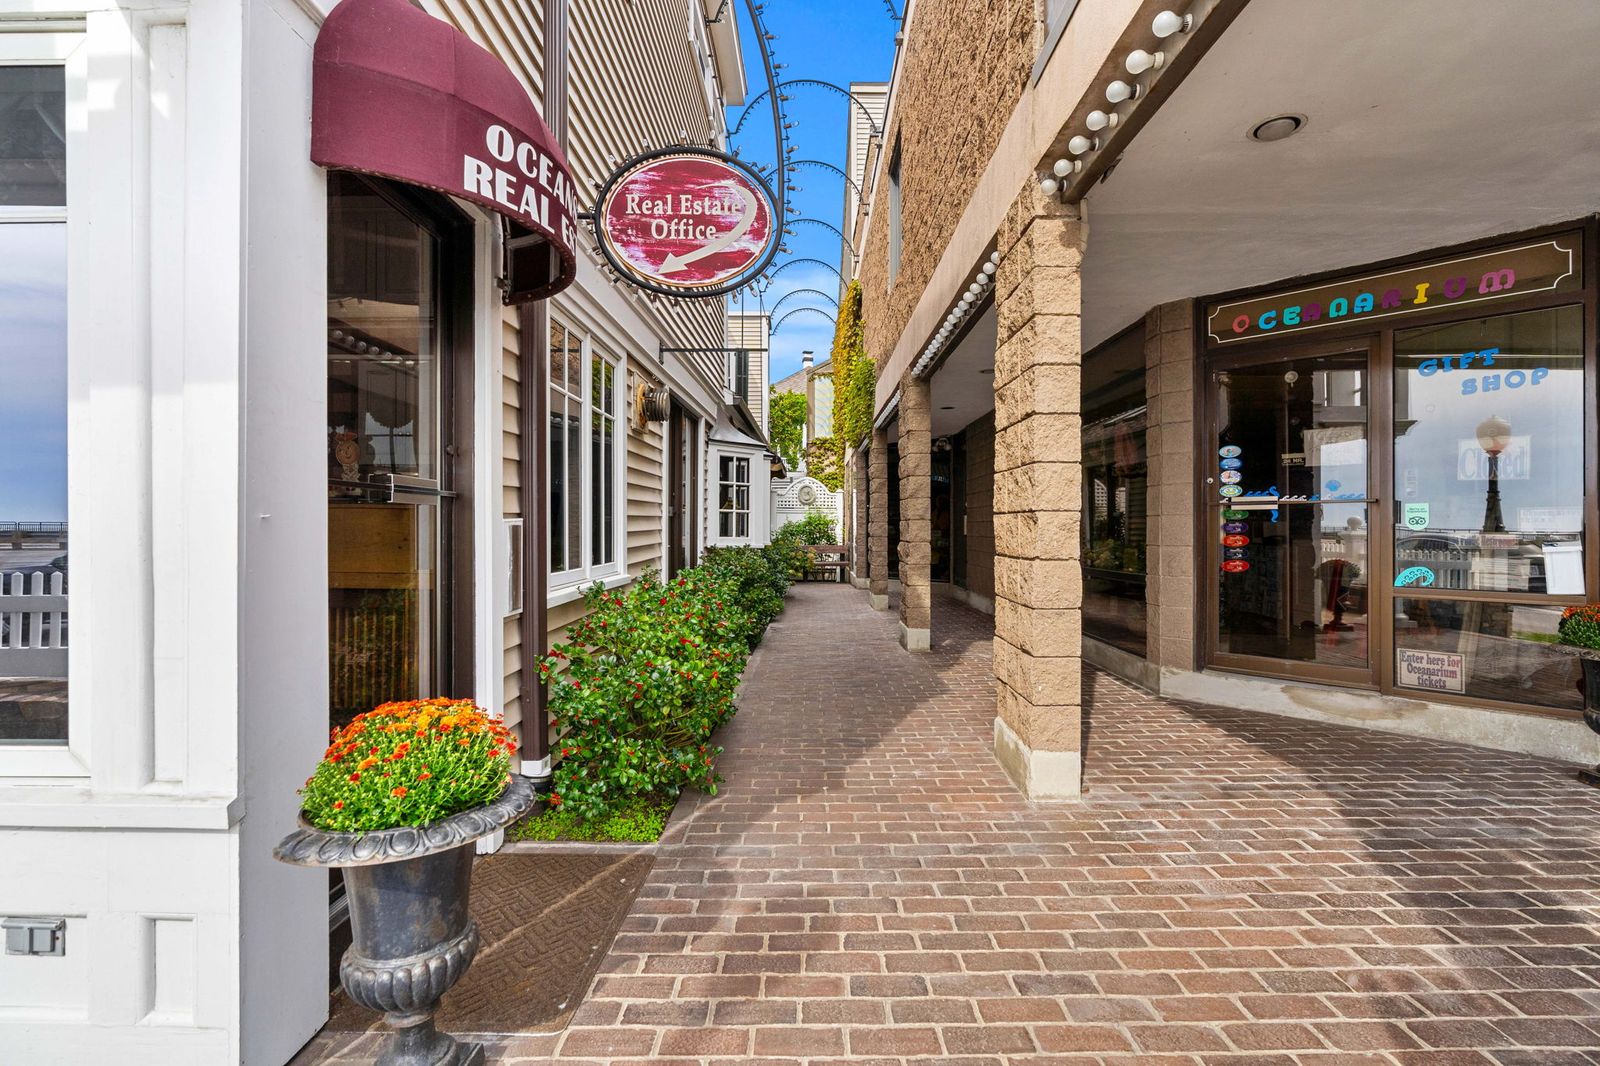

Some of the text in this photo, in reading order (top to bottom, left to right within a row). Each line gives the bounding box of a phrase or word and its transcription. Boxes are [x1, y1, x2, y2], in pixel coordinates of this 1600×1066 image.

[463, 154, 578, 257] REAL ES
[625, 193, 741, 216] Real Estate
[651, 218, 717, 240] Office
[1232, 268, 1516, 334] OCEANARIUM
[1418, 347, 1500, 377] GIFT
[1461, 367, 1549, 396] SHOP
[1400, 650, 1461, 669] Enter here for
[1407, 662, 1458, 679] Oceanarium
[1417, 674, 1447, 689] tickets
